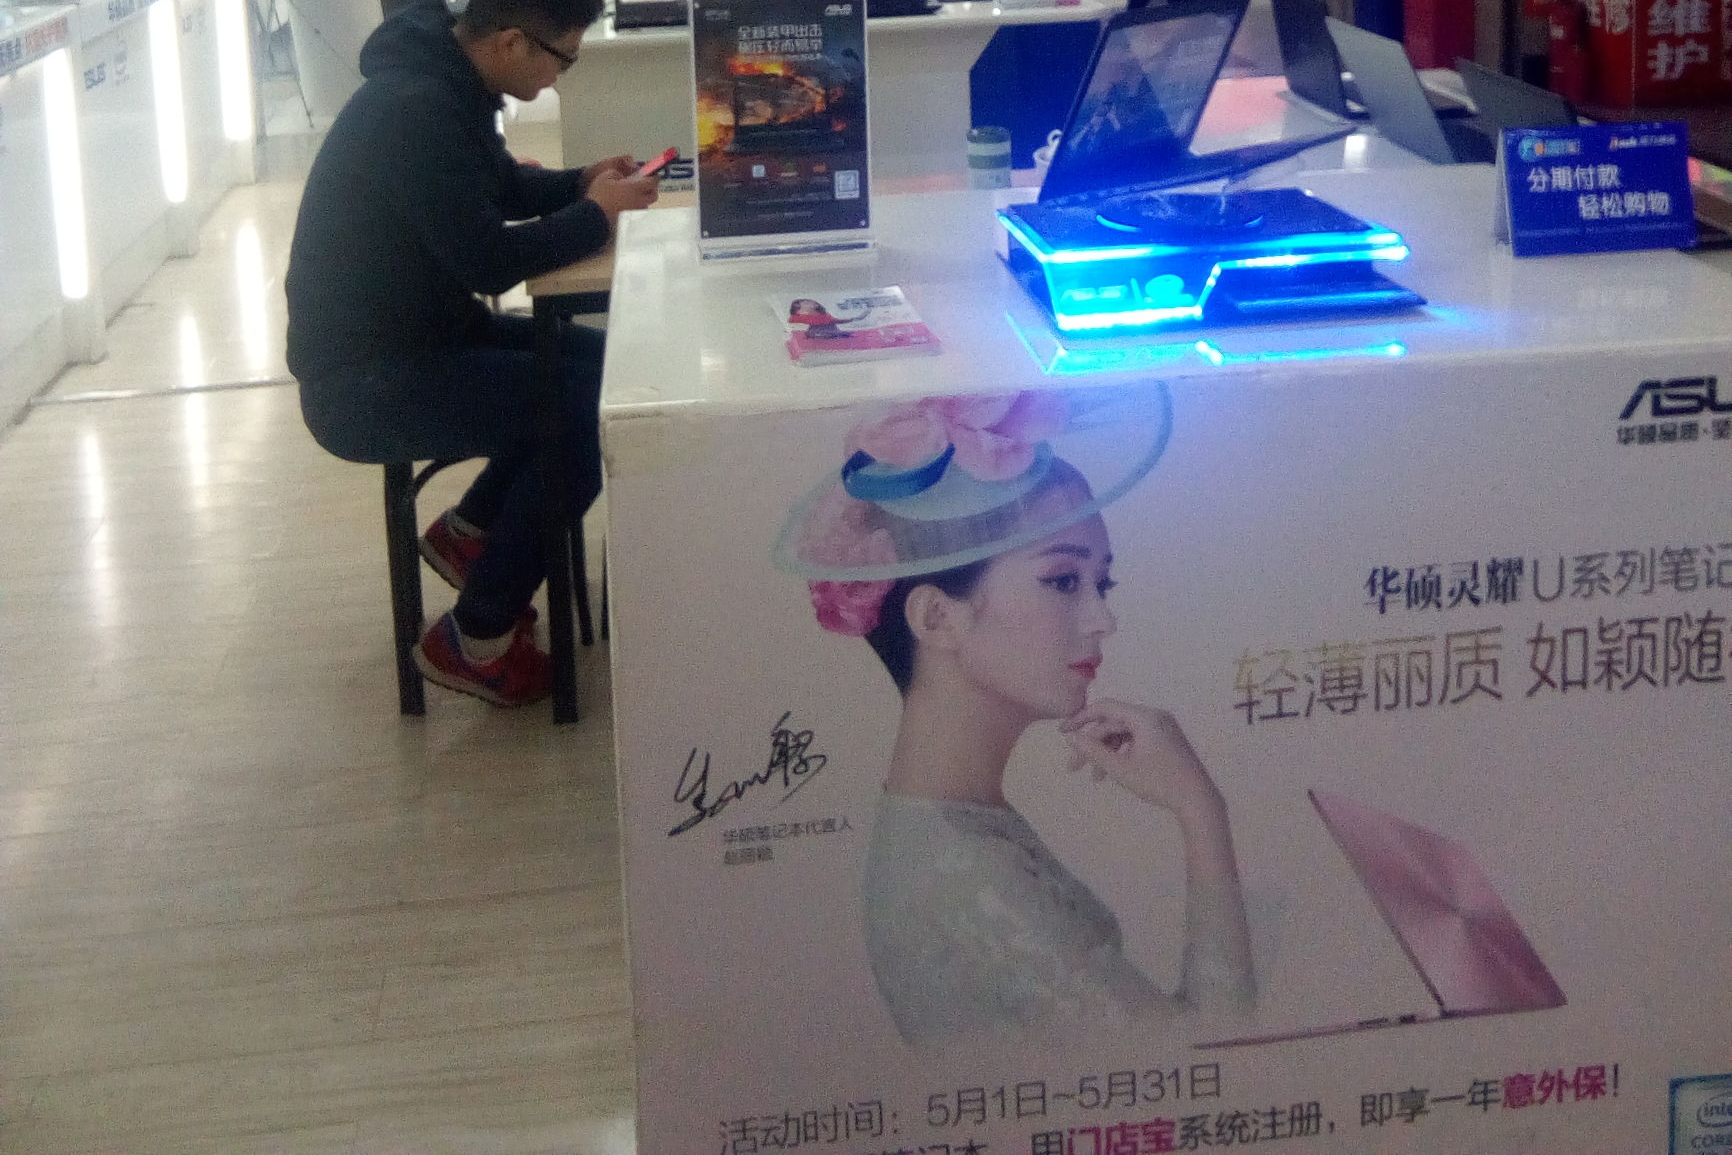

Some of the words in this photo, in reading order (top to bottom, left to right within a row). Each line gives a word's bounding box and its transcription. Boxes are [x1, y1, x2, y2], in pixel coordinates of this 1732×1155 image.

[1526, 163, 1623, 194] 分期付款
[1577, 190, 1672, 220] 轻松购物
[1363, 543, 1732, 614] 华硕灵耀U系列笔记
[1232, 625, 1503, 726] 轻薄丽质
[1526, 608, 1732, 698] 如颖随
